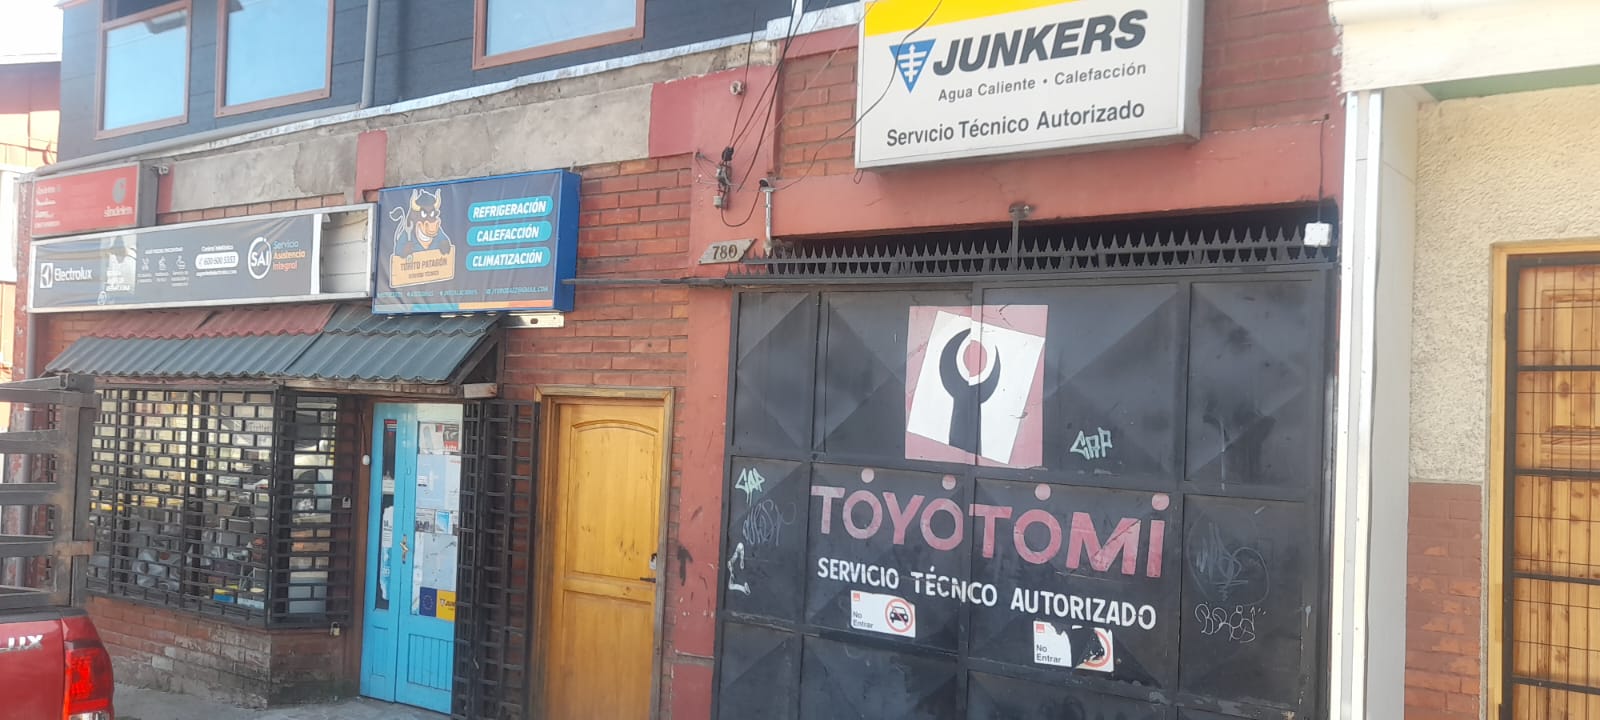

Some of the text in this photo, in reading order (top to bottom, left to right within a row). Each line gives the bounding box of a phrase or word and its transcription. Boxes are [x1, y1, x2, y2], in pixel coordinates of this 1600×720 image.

[933, 9, 1148, 76] JUNKERS
[938, 62, 1147, 102] Agua Caliente Calefacción
[886, 99, 1145, 146] Servicio Técnico Autorizado
[472, 197, 547, 219] REFRIGERACIÓN
[476, 223, 540, 243] CALEFACCIÓN
[251, 250, 270, 267] SAI
[472, 248, 543, 268] CLIMATIZACIÓN
[712, 244, 738, 260] 780
[54, 266, 92, 281] Electrolux
[811, 468, 1170, 578] TOYOTOMI
[817, 557, 899, 589] SERVICIO
[1010, 587, 1157, 630] AUTORIZADO
[853, 610, 863, 619] No
[853, 619, 874, 629] Entrar
[1036, 644, 1048, 653] No
[1036, 653, 1061, 663] Entrar
